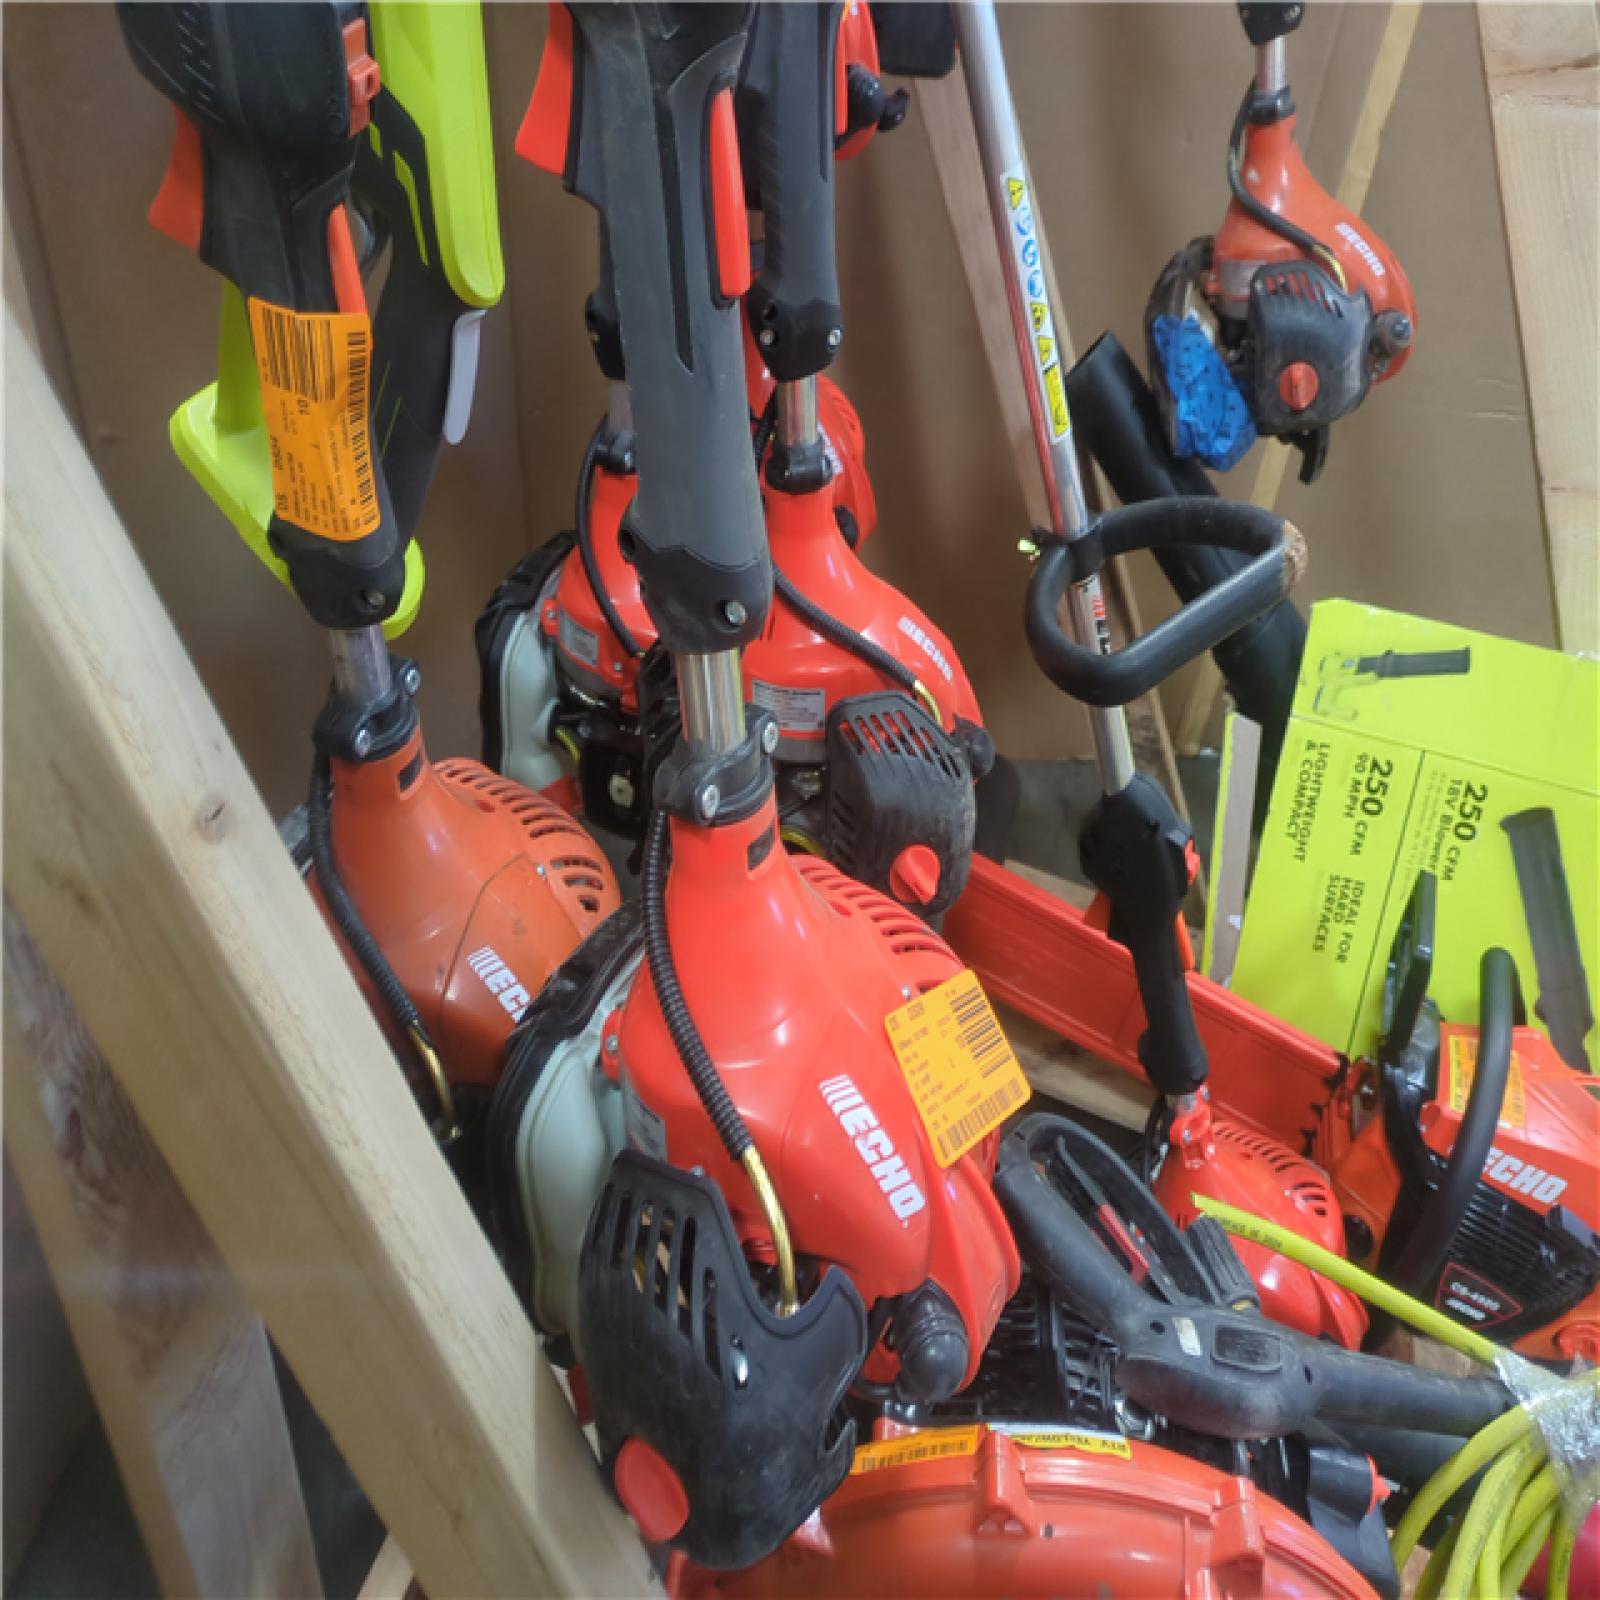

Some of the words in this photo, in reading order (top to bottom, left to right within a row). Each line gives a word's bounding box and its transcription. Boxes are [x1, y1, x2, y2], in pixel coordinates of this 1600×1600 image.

[906, 624, 954, 682] ECHO
[1285, 758, 1315, 840] COMPACT
[1343, 778, 1364, 818] MPH
[1362, 757, 1394, 816] 250
[1455, 780, 1489, 841] 250
[1350, 820, 1369, 856] CFM
[1441, 846, 1461, 881] CFM
[1314, 875, 1341, 952] SURFACES
[1333, 876, 1354, 923] HARD
[1344, 879, 1366, 926] IDEAL
[1336, 931, 1354, 963] FOR
[838, 1102, 926, 1220] ECHO
[1483, 1147, 1569, 1204] ECHO
